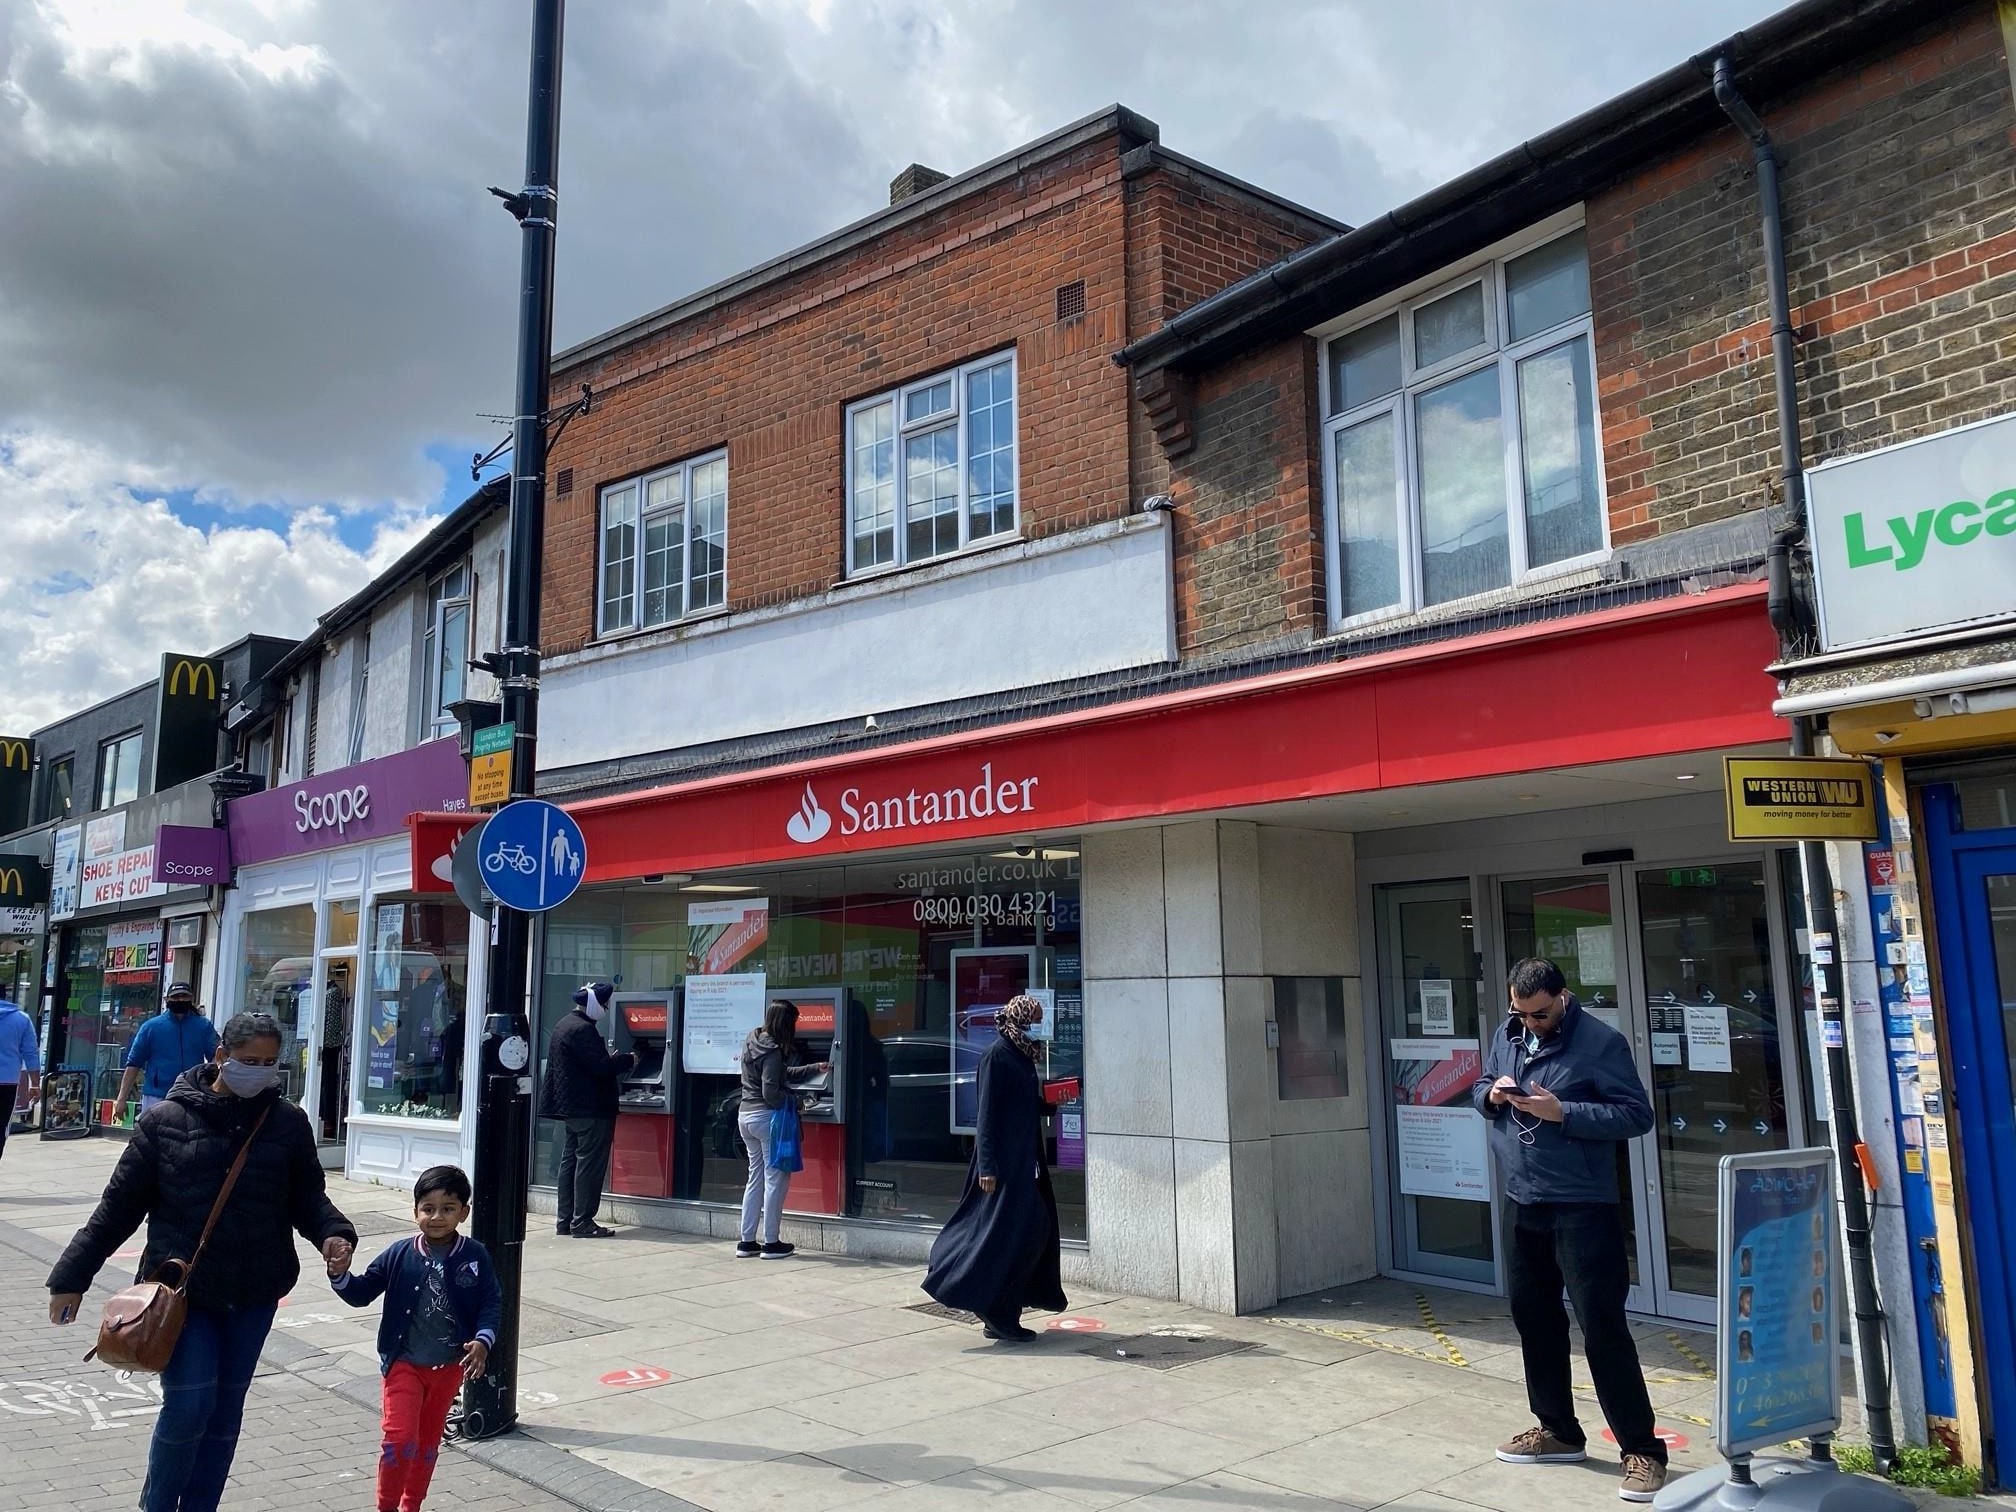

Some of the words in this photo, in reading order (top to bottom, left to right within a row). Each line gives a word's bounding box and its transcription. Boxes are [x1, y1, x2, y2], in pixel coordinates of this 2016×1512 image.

[1843, 487, 2016, 571] Lyca
[484, 769, 504, 779] stopping
[492, 780, 503, 788] time
[1747, 780, 1816, 792] WESTERN
[442, 797, 466, 812] Hayes
[474, 793, 490, 802] except
[490, 790, 504, 799] buses
[840, 762, 1039, 835] Santander
[1771, 791, 1817, 803] UNION
[294, 784, 371, 835] Scope
[1763, 810, 1793, 819] moving
[1795, 811, 1820, 819] money
[1821, 810, 1831, 818] for
[1832, 810, 1852, 818] better
[83, 860, 113, 882] SHOE
[165, 861, 214, 878] Scope
[897, 853, 1057, 889] santander.co.uk
[95, 882, 124, 903] KEYS
[129, 876, 152, 896] CUT
[912, 896, 961, 922] 0800
[966, 893, 1002, 918] 030
[1008, 890, 1057, 915] 4321
[929, 910, 990, 929] Expres
[638, 1012, 667, 1023] Santander
[798, 1013, 833, 1023] Santander
[1430, 1050, 1478, 1098] Santander
